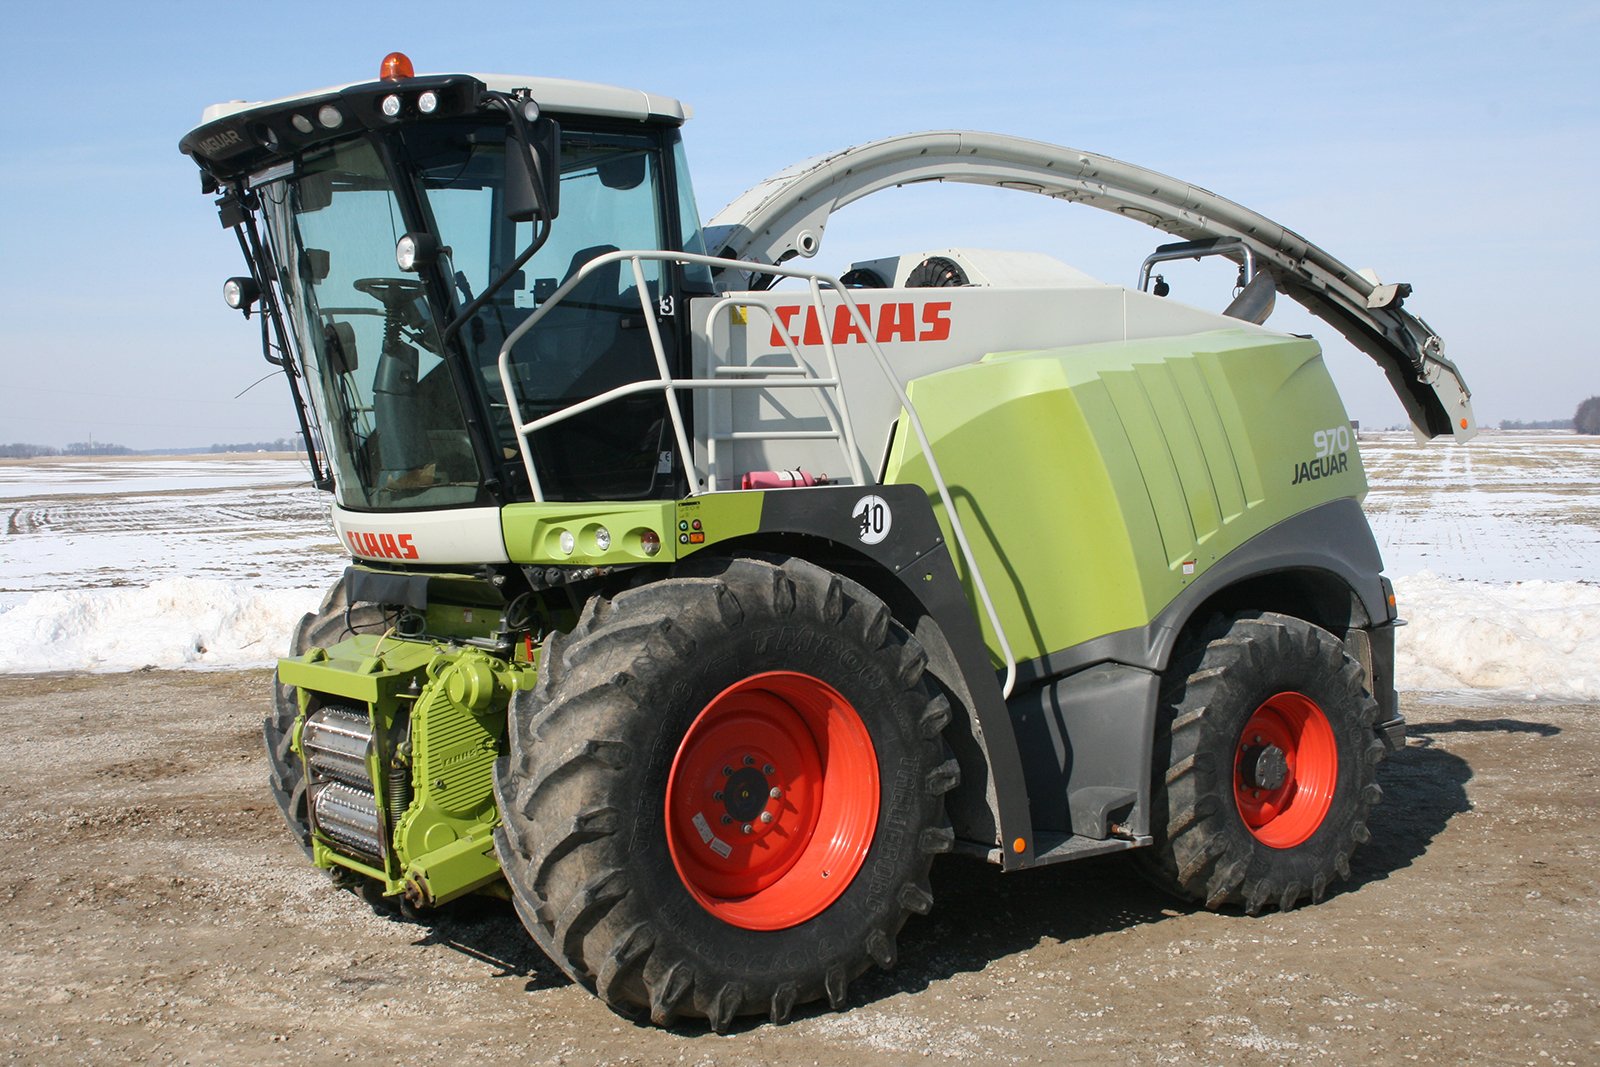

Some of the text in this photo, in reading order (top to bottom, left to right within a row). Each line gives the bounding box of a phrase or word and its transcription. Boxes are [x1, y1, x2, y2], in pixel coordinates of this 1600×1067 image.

[199, 130, 242, 155] JAGUAR
[770, 302, 952, 347] CLAAS
[1314, 425, 1350, 458] 970
[1292, 452, 1348, 485] JAGUAR
[860, 503, 884, 534] 40
[347, 531, 419, 559] CLAAS
